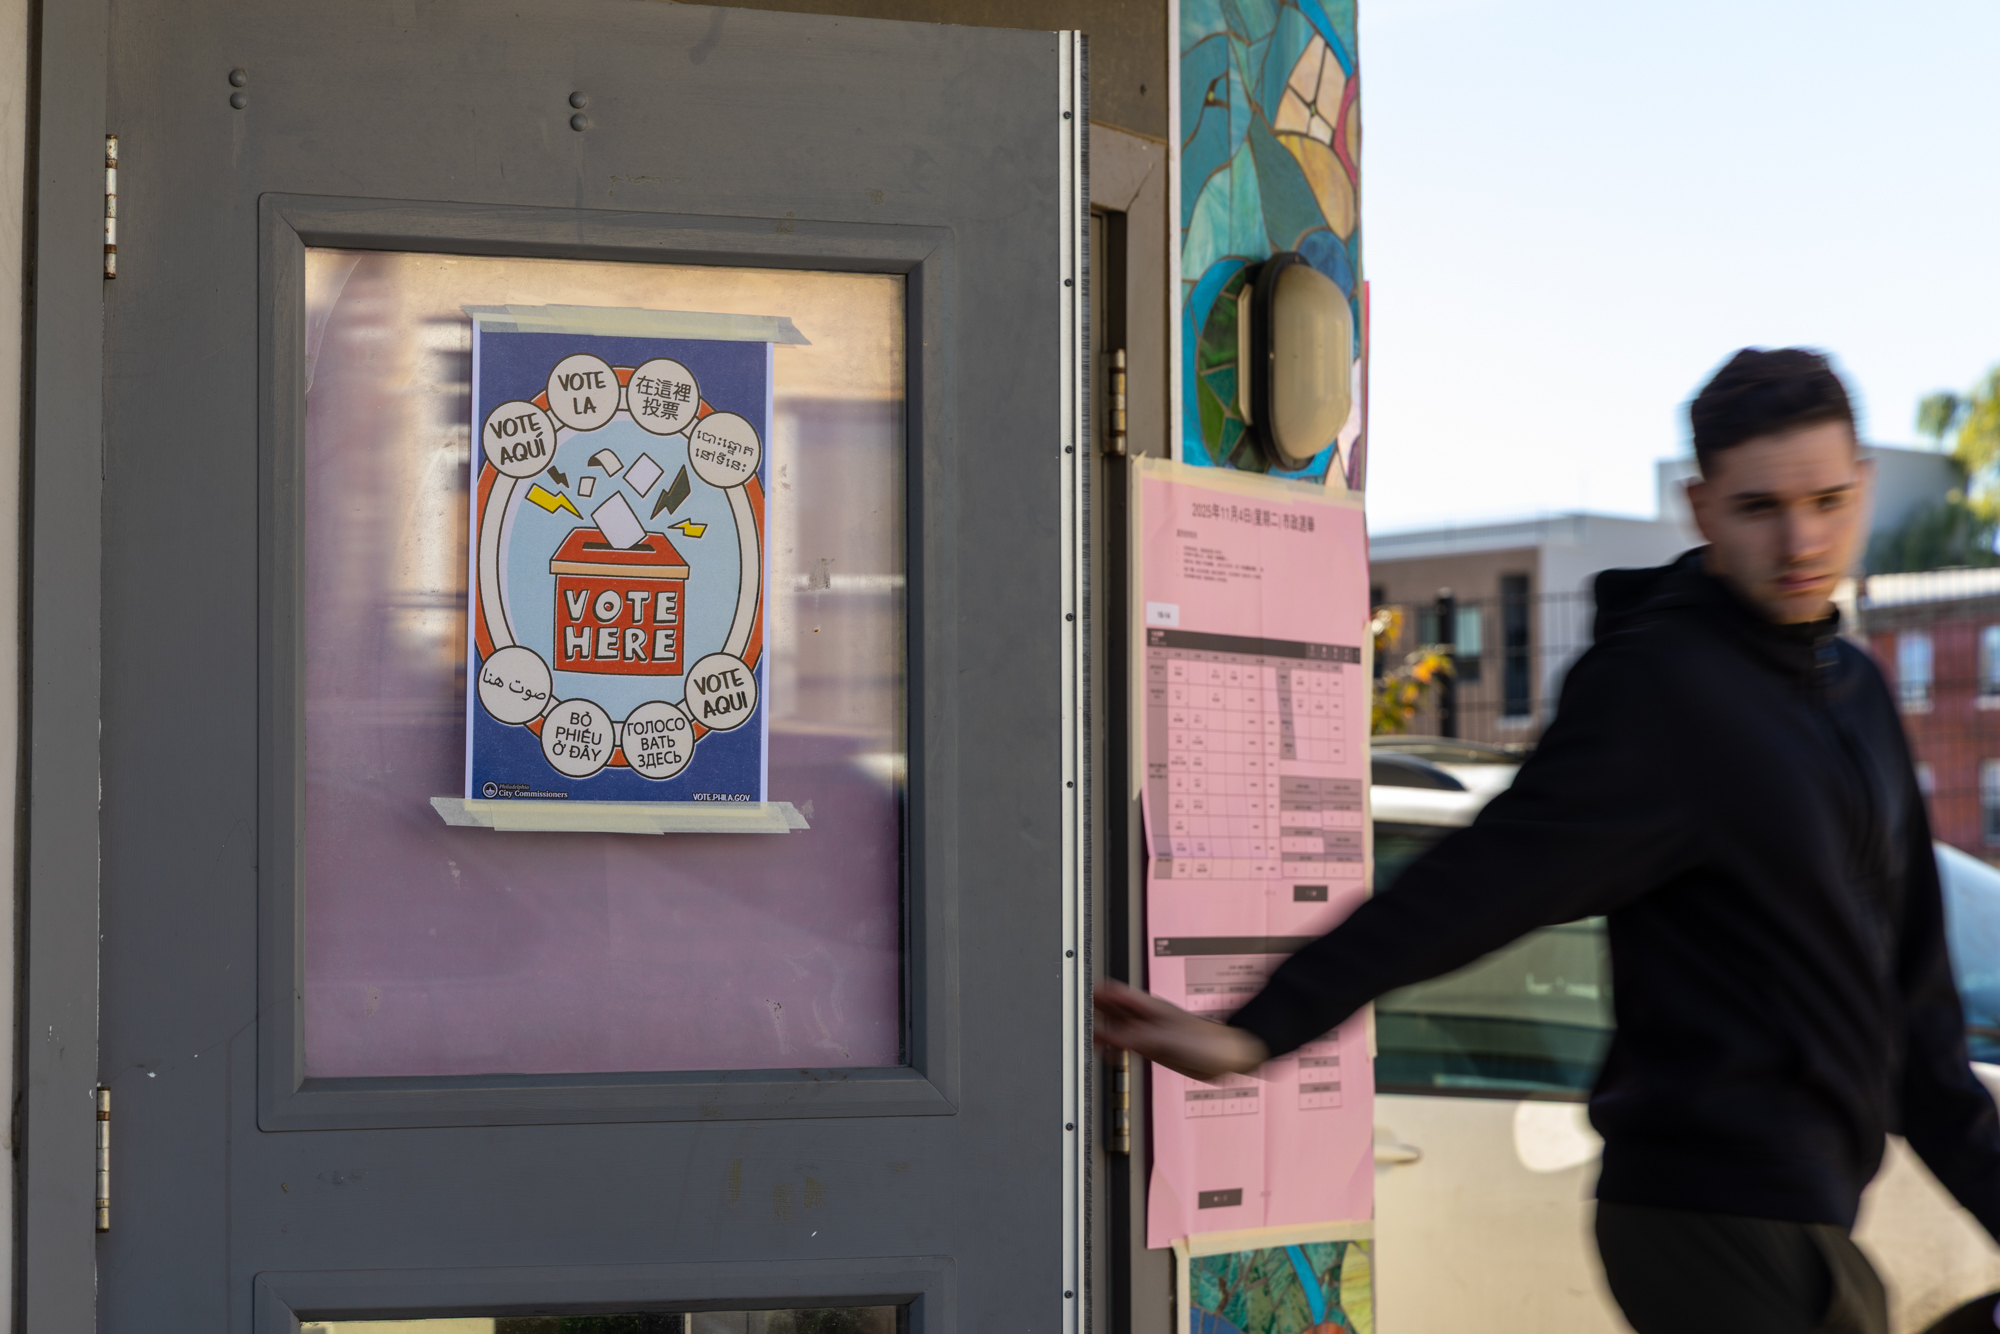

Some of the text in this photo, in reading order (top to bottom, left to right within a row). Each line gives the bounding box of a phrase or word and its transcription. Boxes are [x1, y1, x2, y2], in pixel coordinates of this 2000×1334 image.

[558, 371, 606, 391] VOTE
[635, 375, 692, 404] 在這裡
[573, 397, 597, 415] LA
[642, 397, 680, 421] 投票
[489, 413, 541, 440] VOTE
[500, 432, 547, 465] AQUÍ
[563, 588, 679, 625] VOTE
[563, 626, 677, 663] HERE
[483, 668, 546, 701] صوت هنا
[693, 668, 744, 695] VOTE
[704, 691, 748, 719] AQUI
[570, 711, 592, 727] BỎ
[627, 717, 686, 736] ГОЛОСО
[552, 740, 602, 762] Ở ĐÂY
[640, 735, 676, 751] ВАТЬ
[638, 751, 682, 769] ЗДЕСЬ
[498, 789, 568, 799] City Commissioners
[692, 792, 751, 802] VOTE.PHILA.GOV
